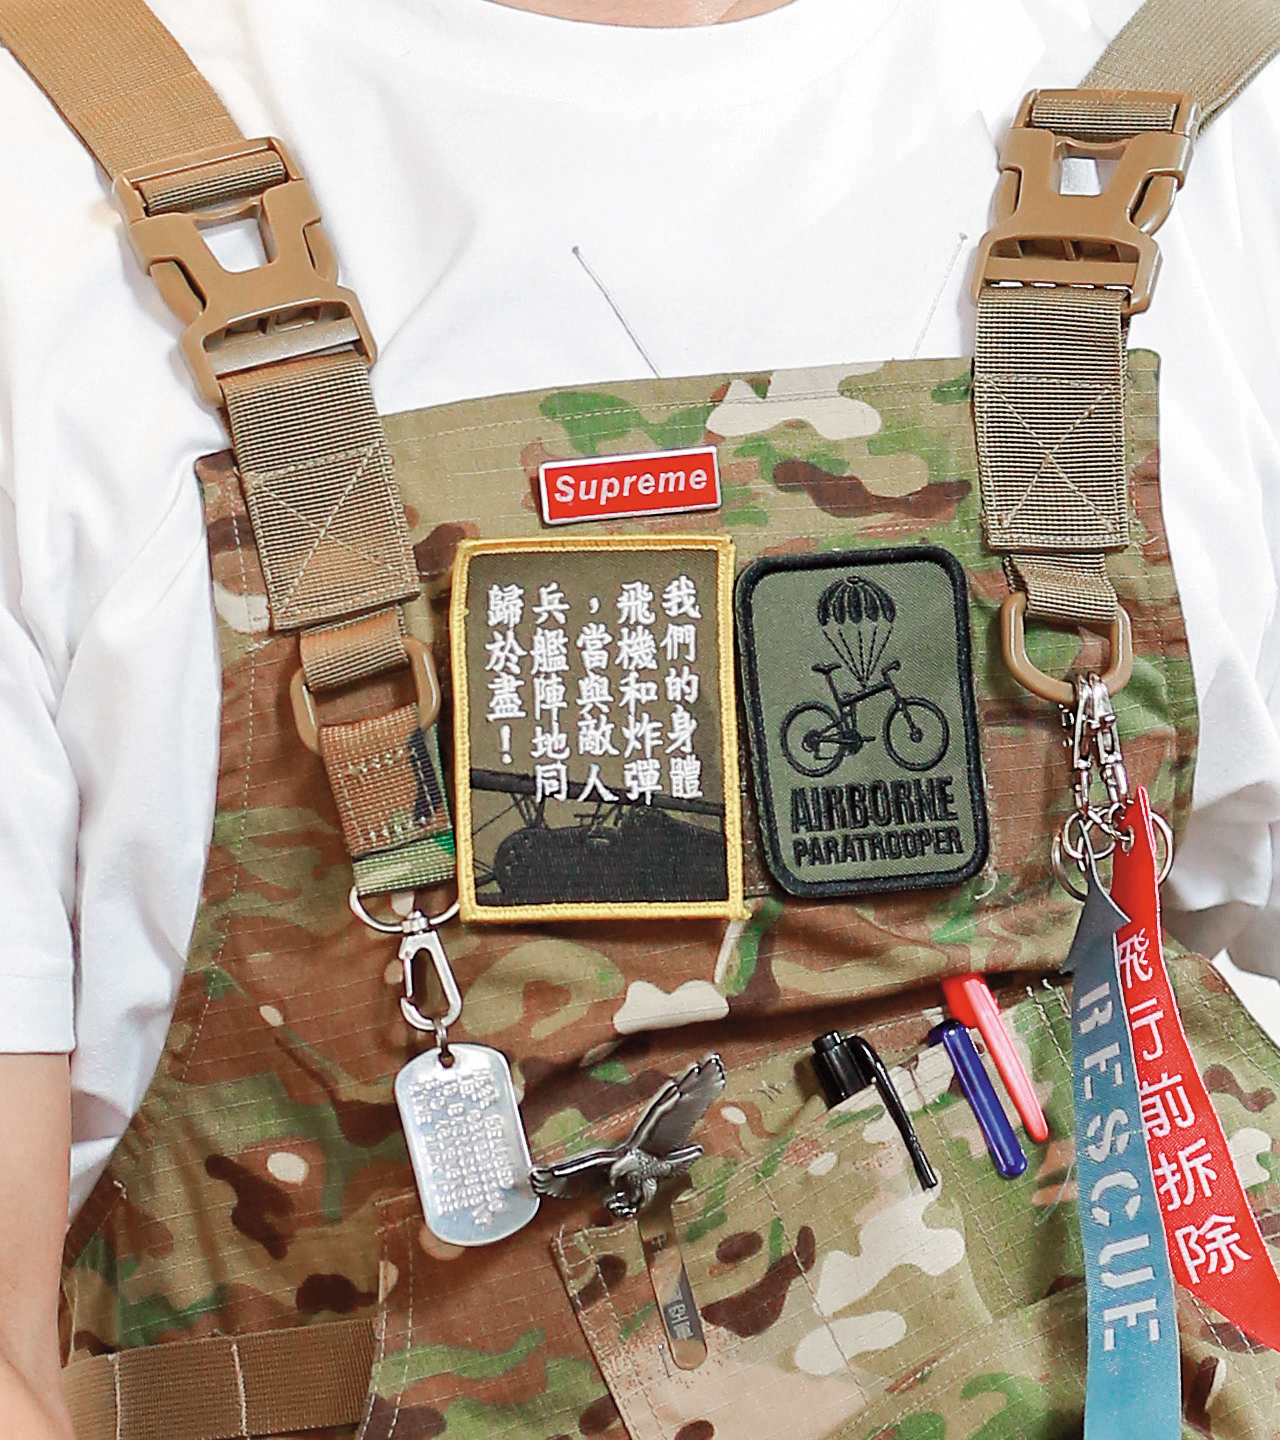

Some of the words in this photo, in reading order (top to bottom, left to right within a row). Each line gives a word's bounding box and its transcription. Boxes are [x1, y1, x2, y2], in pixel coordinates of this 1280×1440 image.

[554, 468, 708, 506] Supreme
[530, 581, 570, 804] 兵艦陣地同
[615, 580, 663, 807] 飛機和炸彈
[660, 574, 703, 800] 我們的身體
[791, 776, 959, 833] AIRBORNE
[793, 826, 964, 868] PARATROOPER
[1078, 981, 1161, 1353] RESCUE
[1117, 926, 1252, 1286] 飛行前拆除
